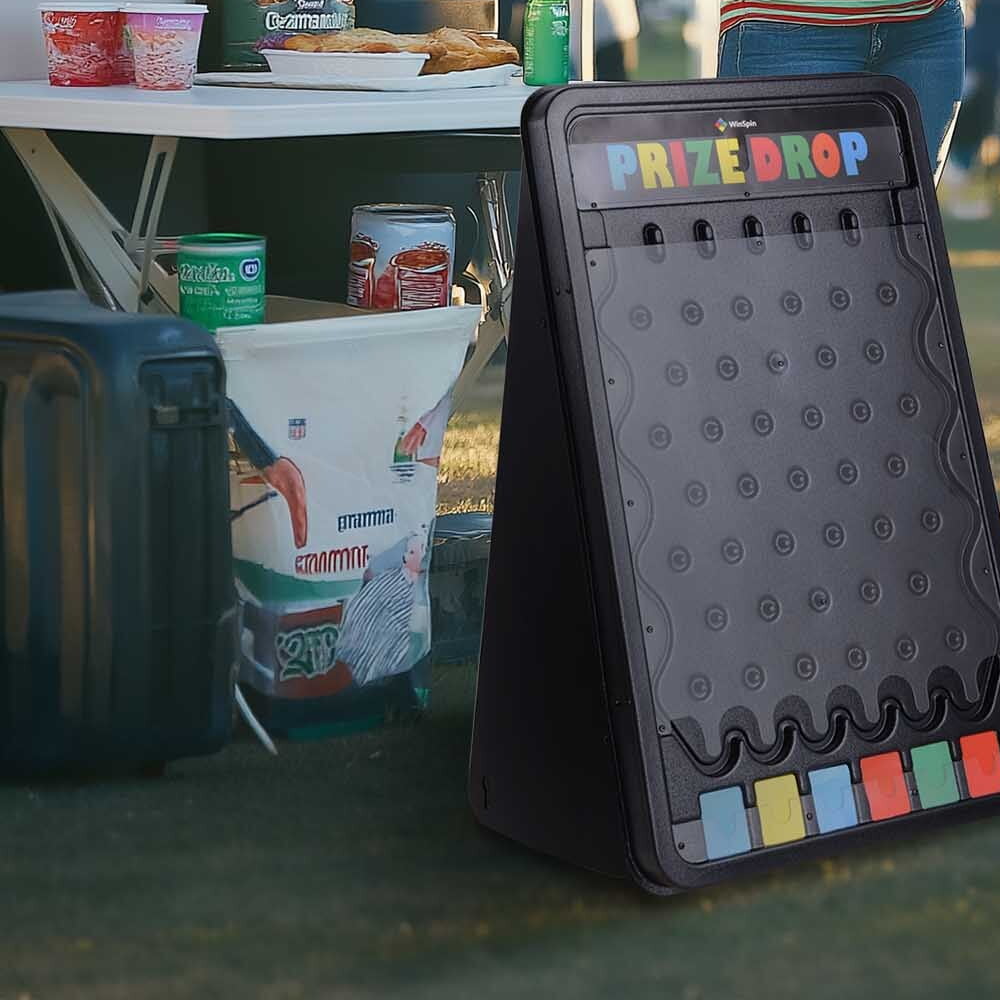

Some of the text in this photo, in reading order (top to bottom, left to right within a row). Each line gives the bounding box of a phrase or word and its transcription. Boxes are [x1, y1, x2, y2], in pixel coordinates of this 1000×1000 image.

[728, 119, 757, 129] WinSpin
[606, 131, 868, 191] PRIZE DROP
